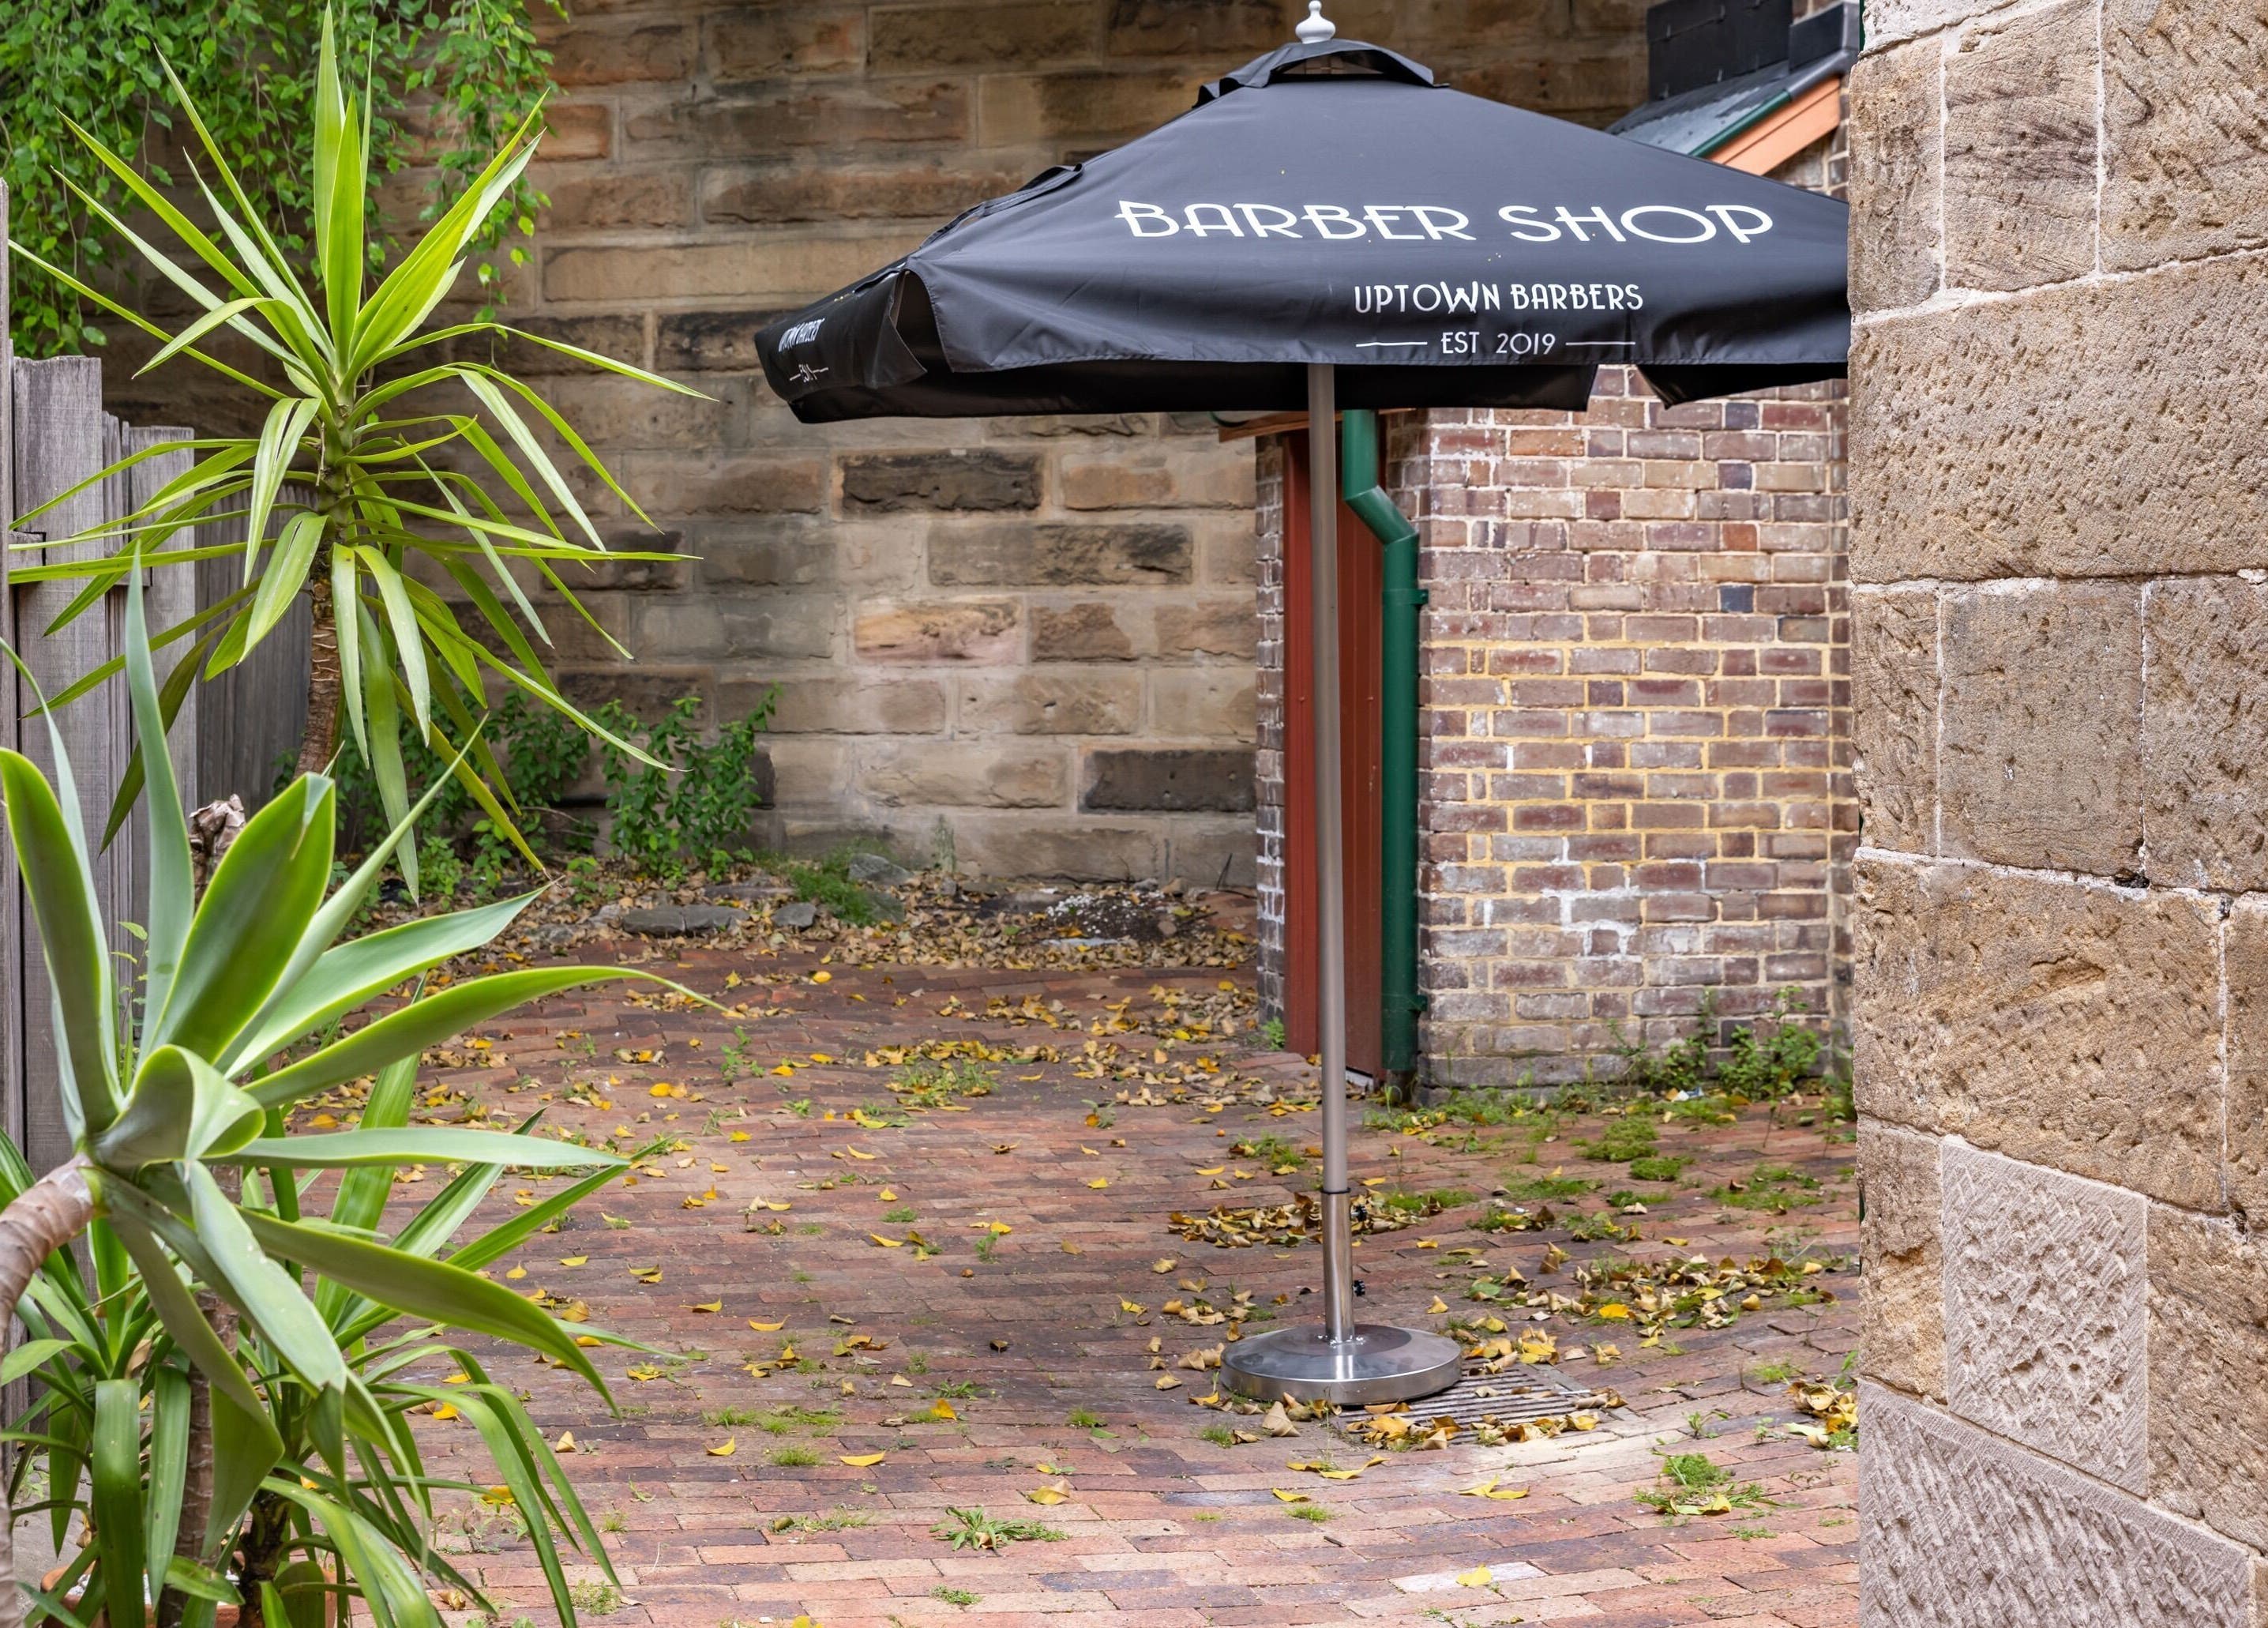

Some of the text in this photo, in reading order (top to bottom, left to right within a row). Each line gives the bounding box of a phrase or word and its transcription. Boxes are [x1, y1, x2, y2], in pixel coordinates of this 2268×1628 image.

[1114, 200, 1774, 244] BARBER SHOP
[1354, 280, 1644, 314] UPTOWN BARBERS
[1440, 331, 1556, 355] EST 2019
